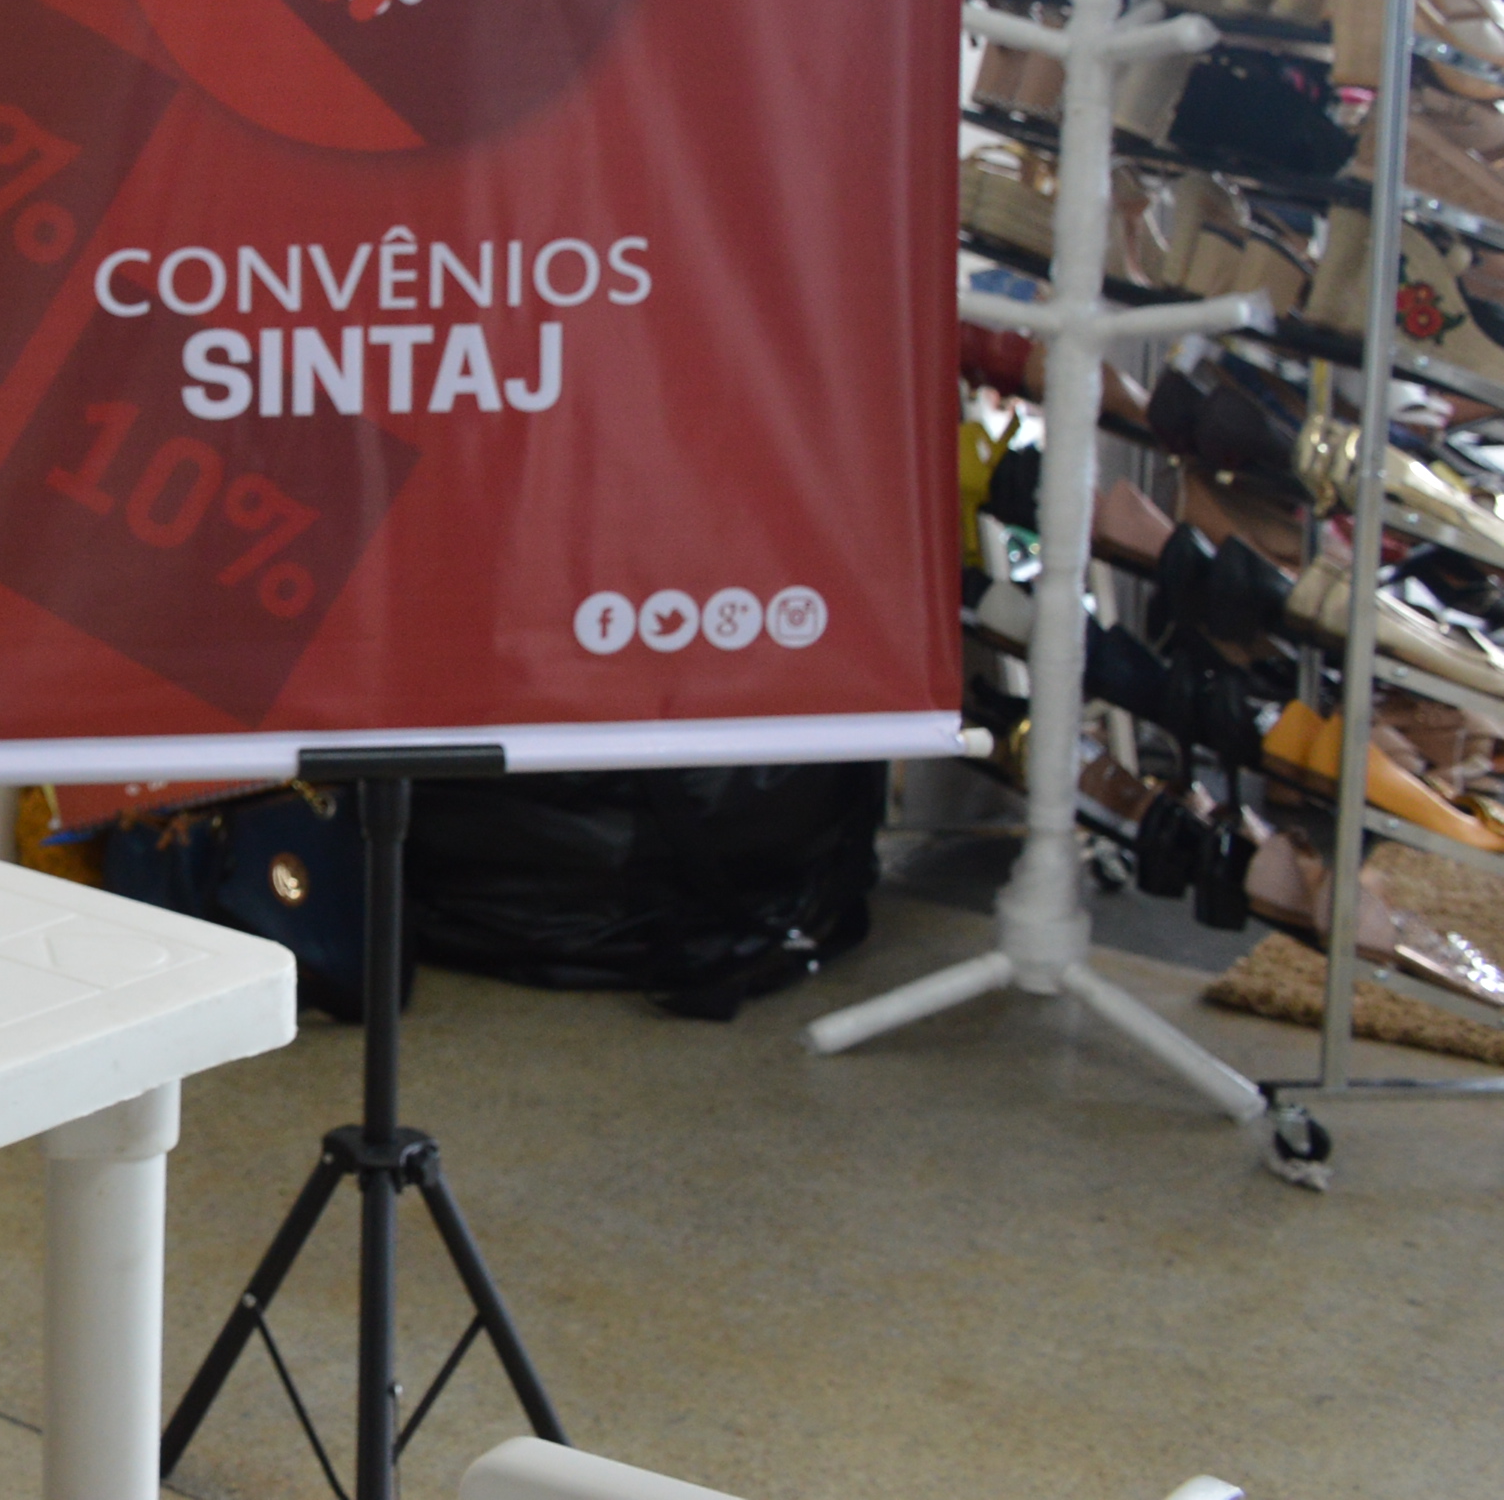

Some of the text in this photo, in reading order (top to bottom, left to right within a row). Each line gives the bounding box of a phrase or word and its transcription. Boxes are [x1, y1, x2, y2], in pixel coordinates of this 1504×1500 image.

[94, 225, 653, 318] CONVÊNIOS
[181, 321, 564, 420] SINTAJ
[44, 401, 322, 618] 10%
